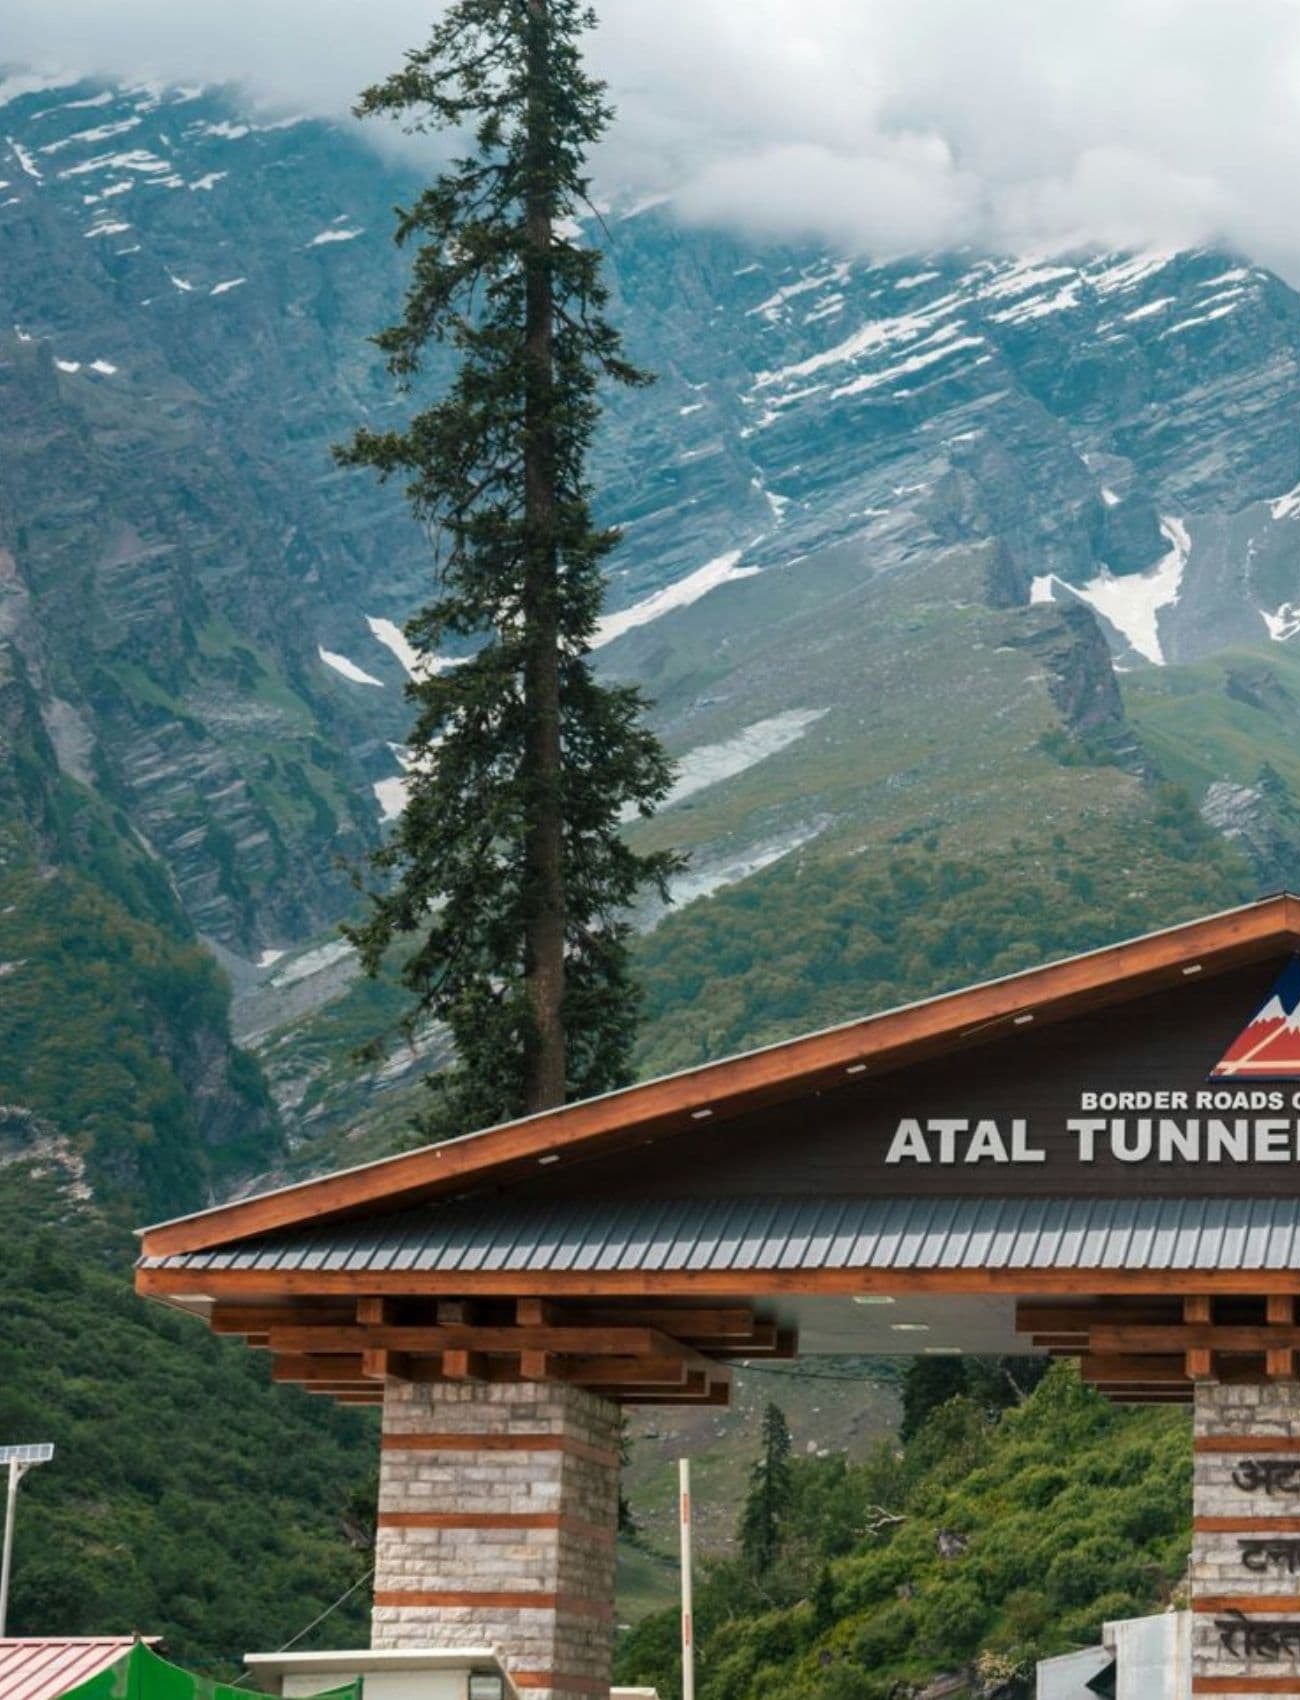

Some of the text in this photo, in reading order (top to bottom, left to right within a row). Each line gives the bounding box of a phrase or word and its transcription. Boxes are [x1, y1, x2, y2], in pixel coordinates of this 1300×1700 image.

[1080, 1090, 1189, 1111] BORDER
[1195, 1090, 1285, 1111] ROADS
[885, 1118, 1046, 1163] ATAL
